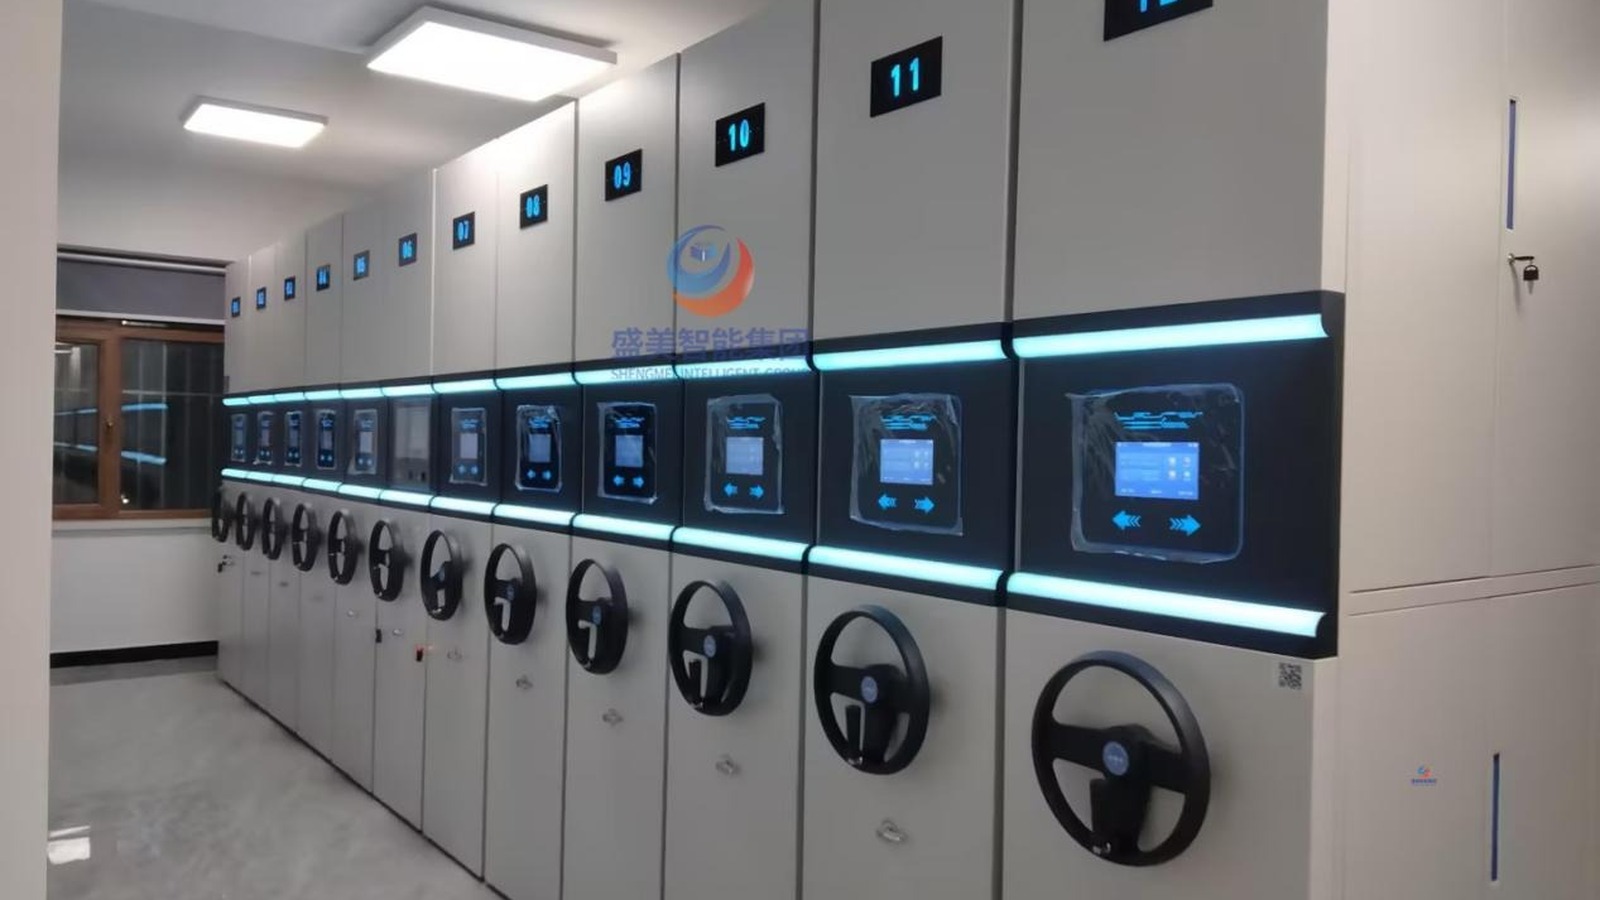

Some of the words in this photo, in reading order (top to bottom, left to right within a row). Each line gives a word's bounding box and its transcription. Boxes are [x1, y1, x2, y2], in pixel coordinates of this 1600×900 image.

[890, 57, 920, 97] 11
[729, 118, 751, 151] 10
[614, 162, 631, 188] 09
[526, 194, 540, 217] 08
[458, 220, 470, 241] 07
